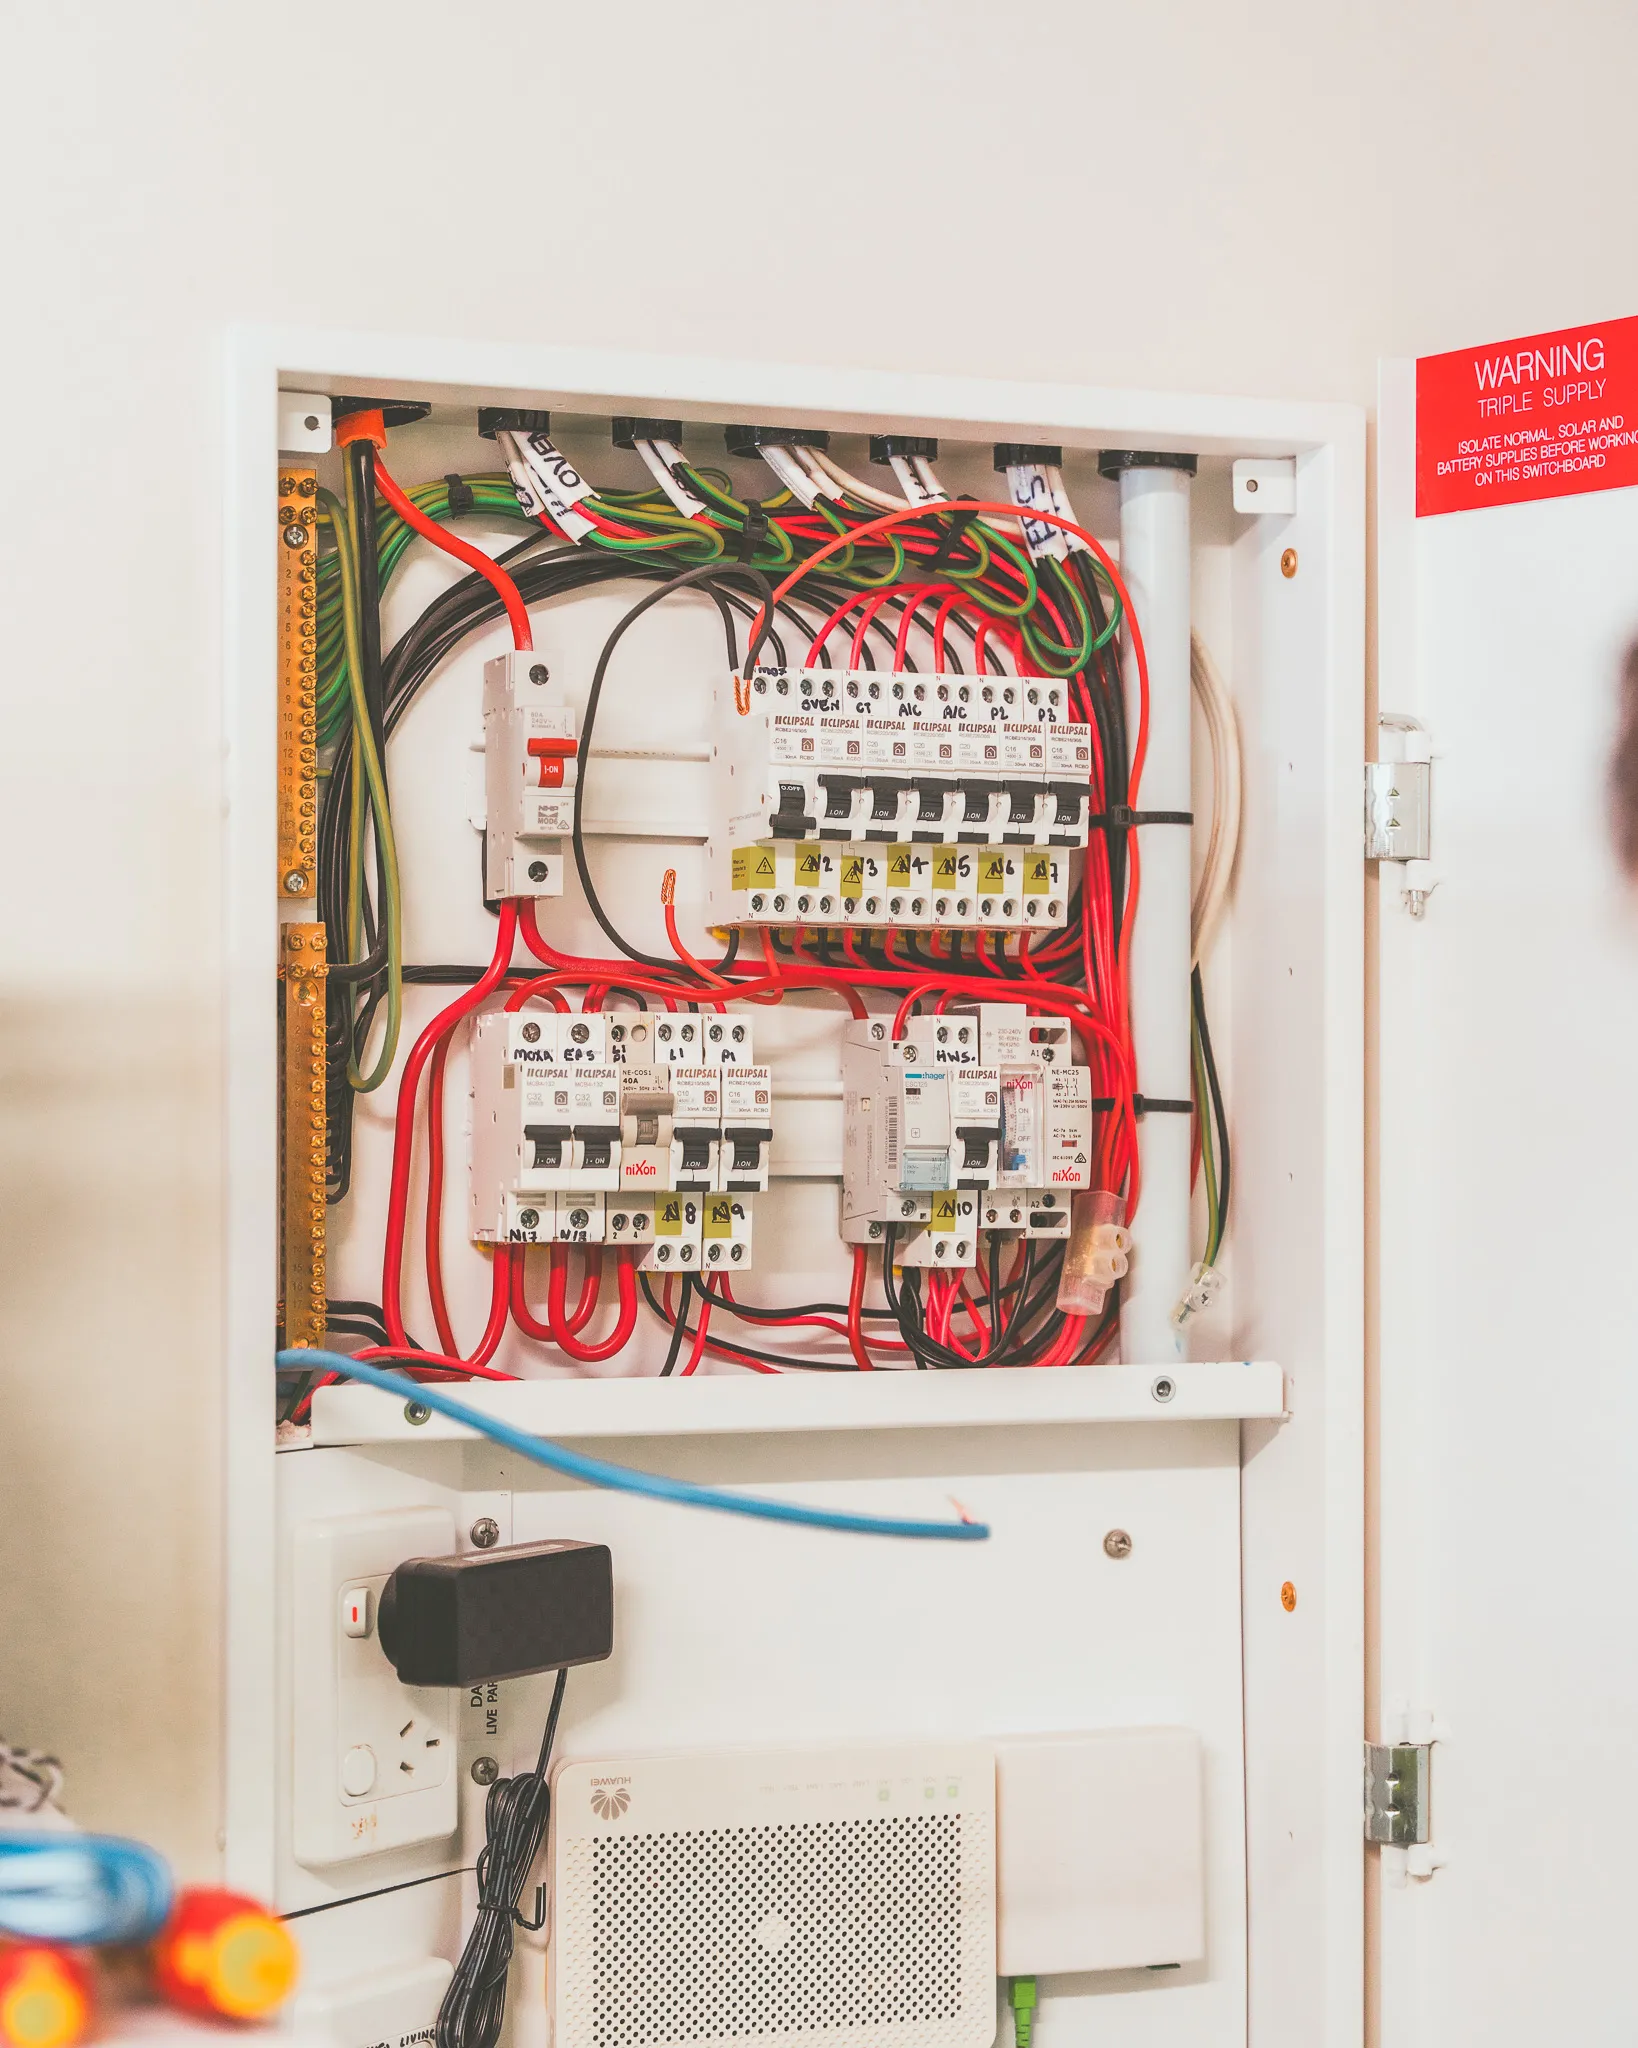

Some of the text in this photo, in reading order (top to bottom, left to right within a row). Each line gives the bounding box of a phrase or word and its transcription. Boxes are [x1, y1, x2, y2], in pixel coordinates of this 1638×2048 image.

[1474, 338, 1605, 391] WARNING
[1477, 378, 1607, 419] TRIPLE SUPPLY
[1458, 414, 1625, 455] ISOLATE NORMAL, SOLAR AND
[1437, 456, 1484, 476] BATTERY
[1485, 447, 1538, 469] SUPPLIES
[1540, 439, 1586, 460] BEFORE
[1474, 453, 1607, 487] ON THIS SWITCHBOARD
[286, 551, 291, 561] 1
[286, 569, 292, 579] 2
[286, 587, 292, 596] 3
[285, 605, 292, 614] 4
[285, 623, 292, 632] 5
[285, 641, 292, 650] 6
[285, 659, 292, 668] 7
[285, 695, 291, 704] 9
[801, 697, 840, 712] OVEN
[855, 702, 871, 714] CT
[283, 713, 293, 722] 10
[990, 706, 1009, 720] P2
[283, 731, 293, 740] 11
[283, 749, 293, 758] 12
[283, 767, 293, 776] 13
[538, 817, 558, 825] MOD6
[1030, 1049, 1040, 1057] A1
[526, 1093, 542, 1101] C32
[574, 1093, 591, 1101] C32
[612, 1231, 639, 1240] 2 4
[485, 1709, 497, 1735] LIVE
[589, 1776, 632, 1787] HUAWEI
